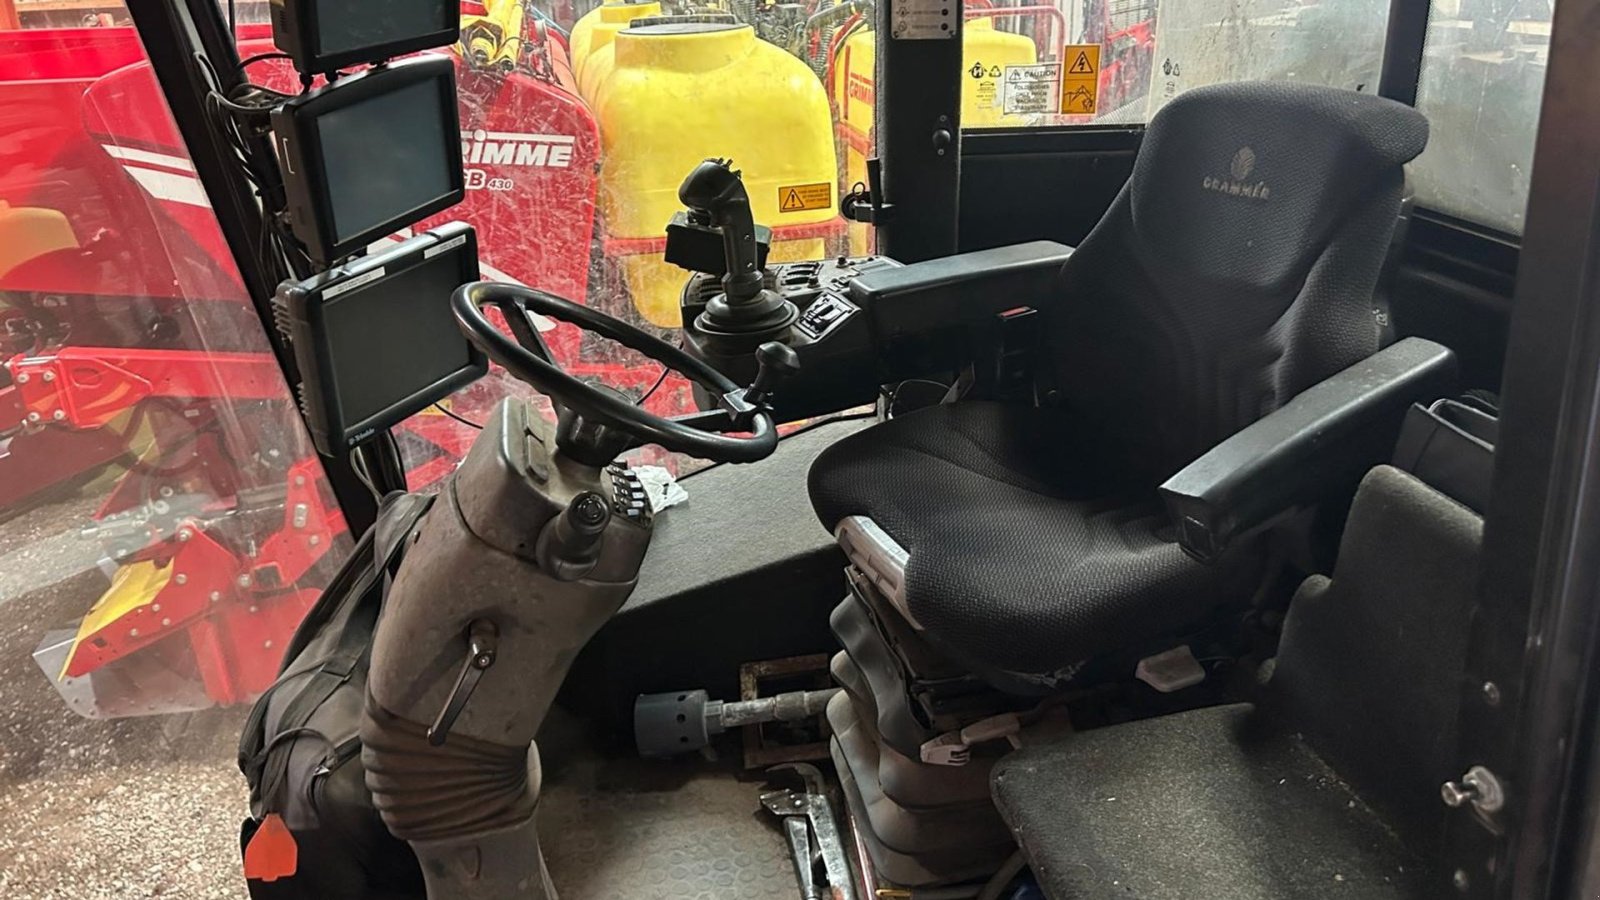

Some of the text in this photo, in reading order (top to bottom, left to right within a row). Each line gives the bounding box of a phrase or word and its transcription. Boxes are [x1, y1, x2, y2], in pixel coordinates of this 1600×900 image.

[1024, 70, 1057, 78] CAUTION
[488, 179, 513, 191] 430
[1203, 176, 1269, 199] GRAMMER
